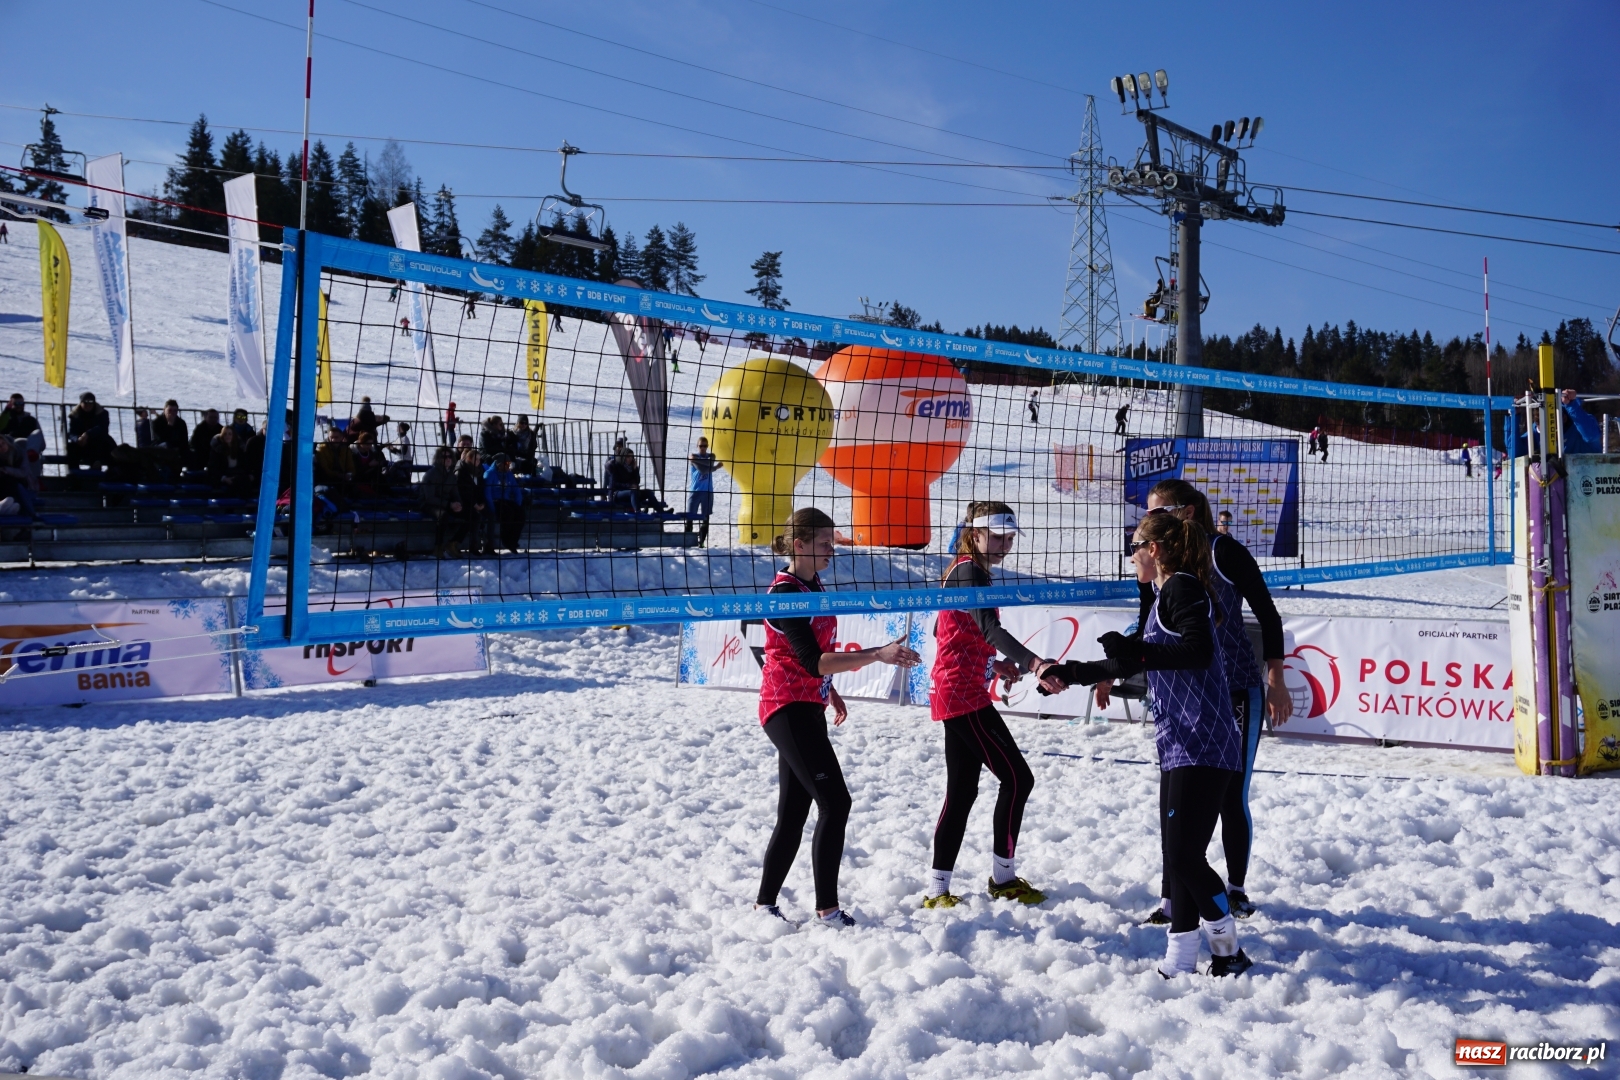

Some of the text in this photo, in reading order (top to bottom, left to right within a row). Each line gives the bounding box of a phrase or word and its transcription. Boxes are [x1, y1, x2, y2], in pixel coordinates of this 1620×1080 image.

[587, 290, 626, 304] BDB EVENT
[804, 322, 823, 333] EVENT
[1130, 441, 1172, 465] SNOW
[1130, 453, 1177, 478] VOLLEY
[778, 601, 810, 611] BDB EVENT
[568, 608, 609, 619] BDB EVENT
[1418, 630, 1499, 641] OFICJALNY PARTNER
[77, 671, 151, 690] Bania
